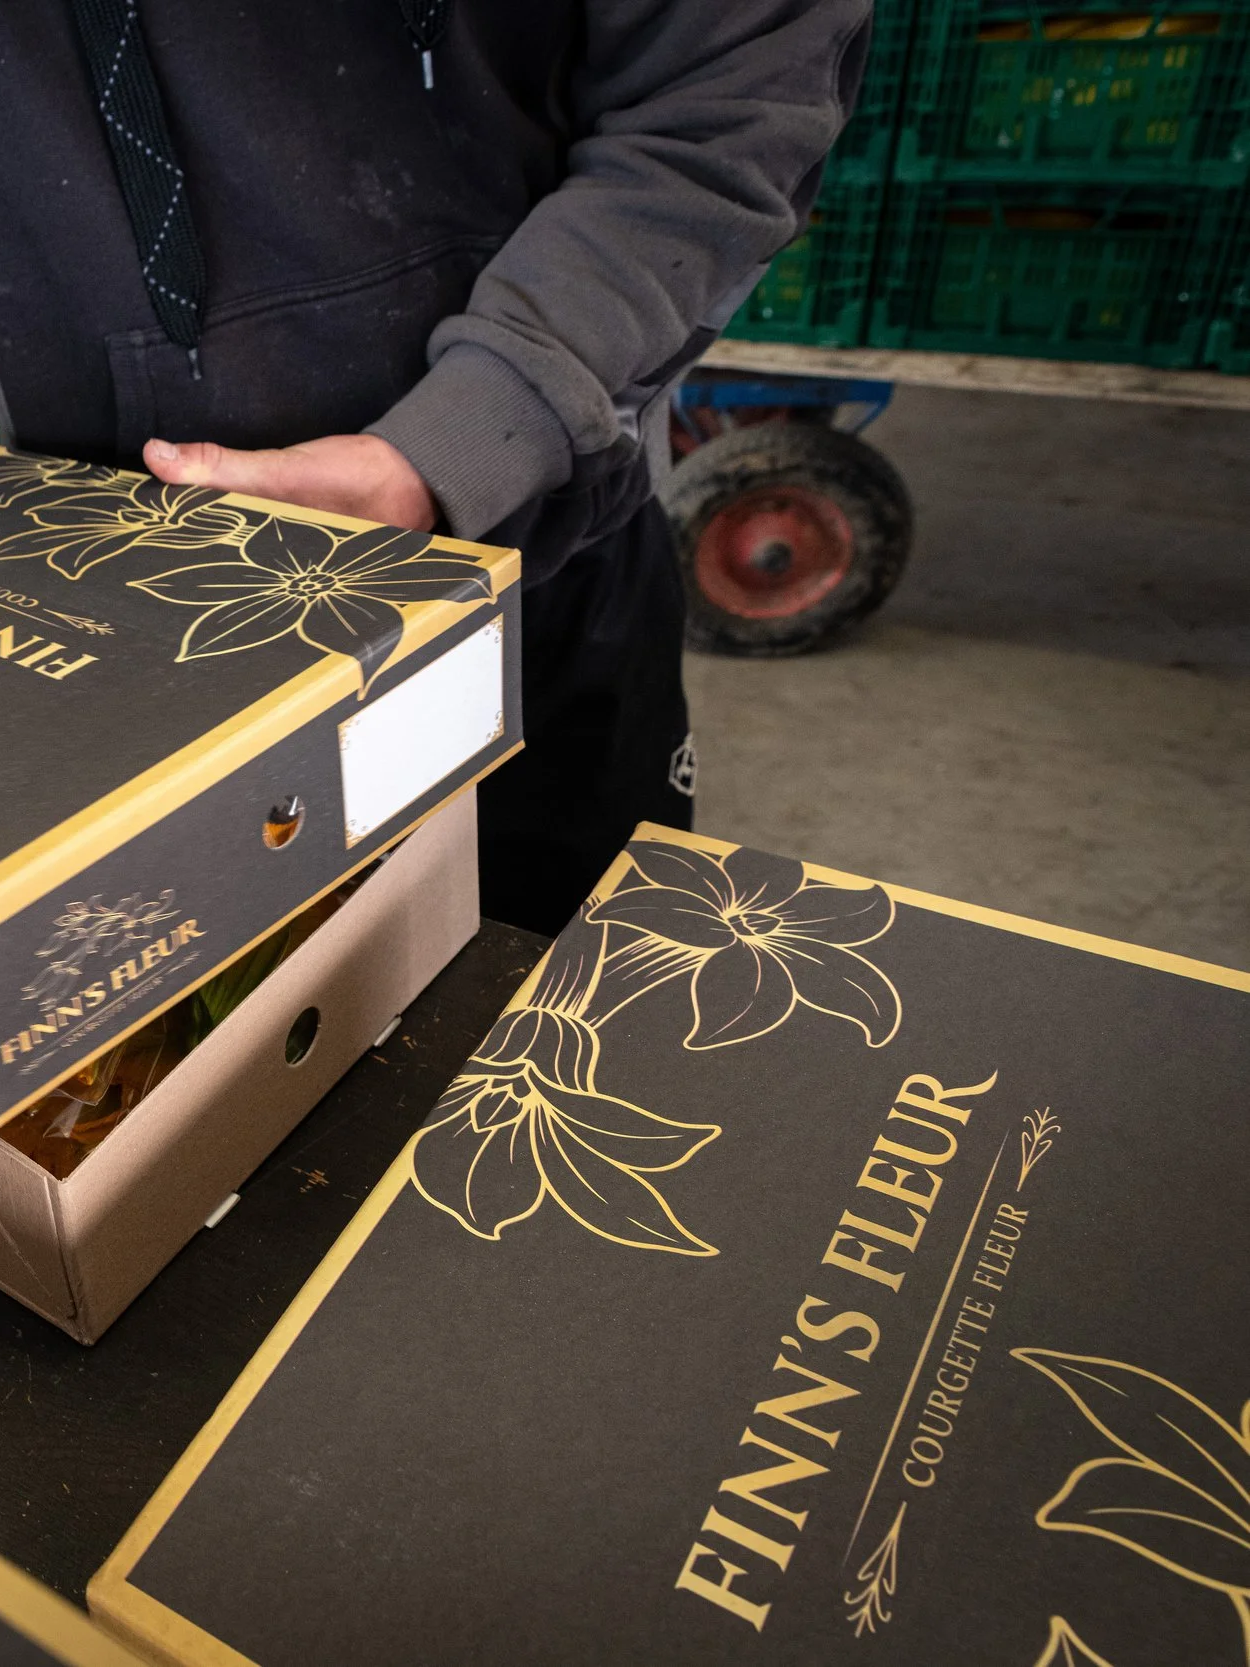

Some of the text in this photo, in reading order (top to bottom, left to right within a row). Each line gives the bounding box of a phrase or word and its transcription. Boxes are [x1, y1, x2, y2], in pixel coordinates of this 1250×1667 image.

[109, 918, 209, 991] FLEUR
[674, 1069, 999, 1633] FINN'S FLEUR
[901, 1203, 1030, 1489] COURGETTE FLEUR
